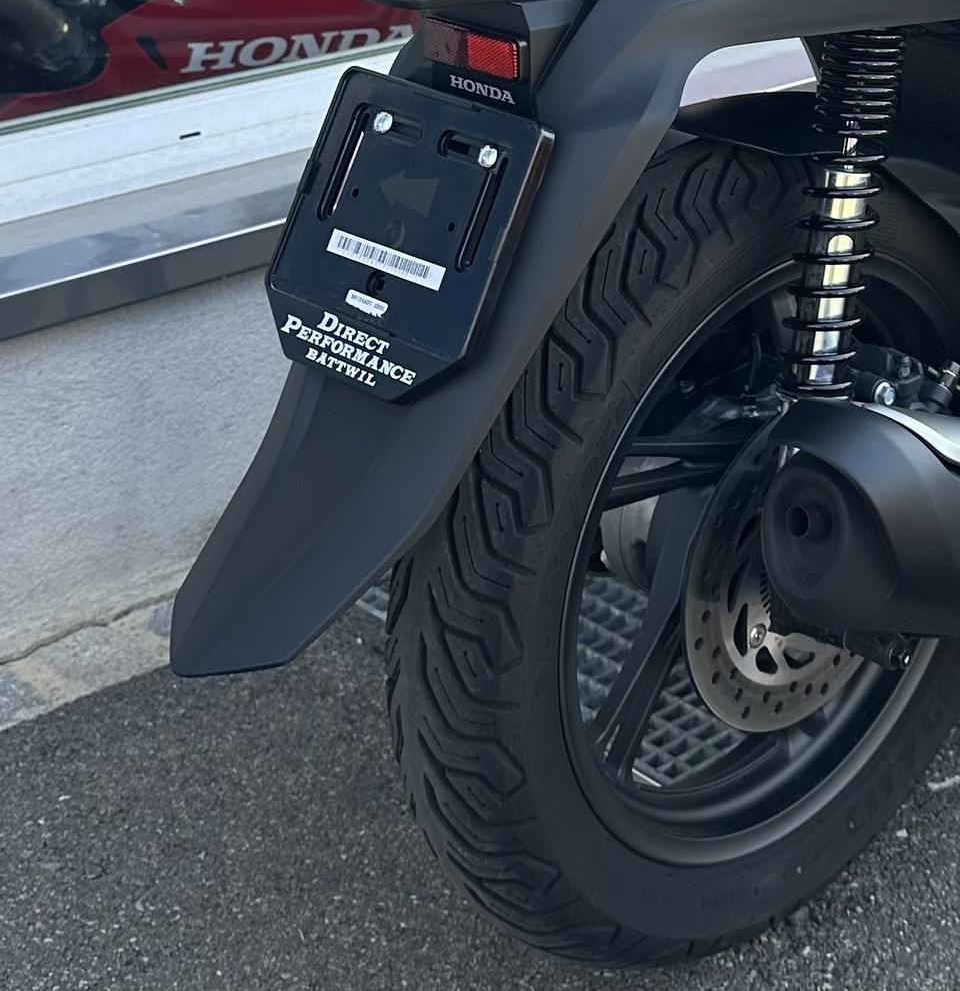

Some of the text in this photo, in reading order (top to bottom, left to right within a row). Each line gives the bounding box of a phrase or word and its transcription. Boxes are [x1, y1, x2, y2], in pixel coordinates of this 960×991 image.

[449, 74, 516, 105] HONDA
[280, 314, 417, 386] PERFORMANCE
[316, 311, 390, 355] DIRECT
